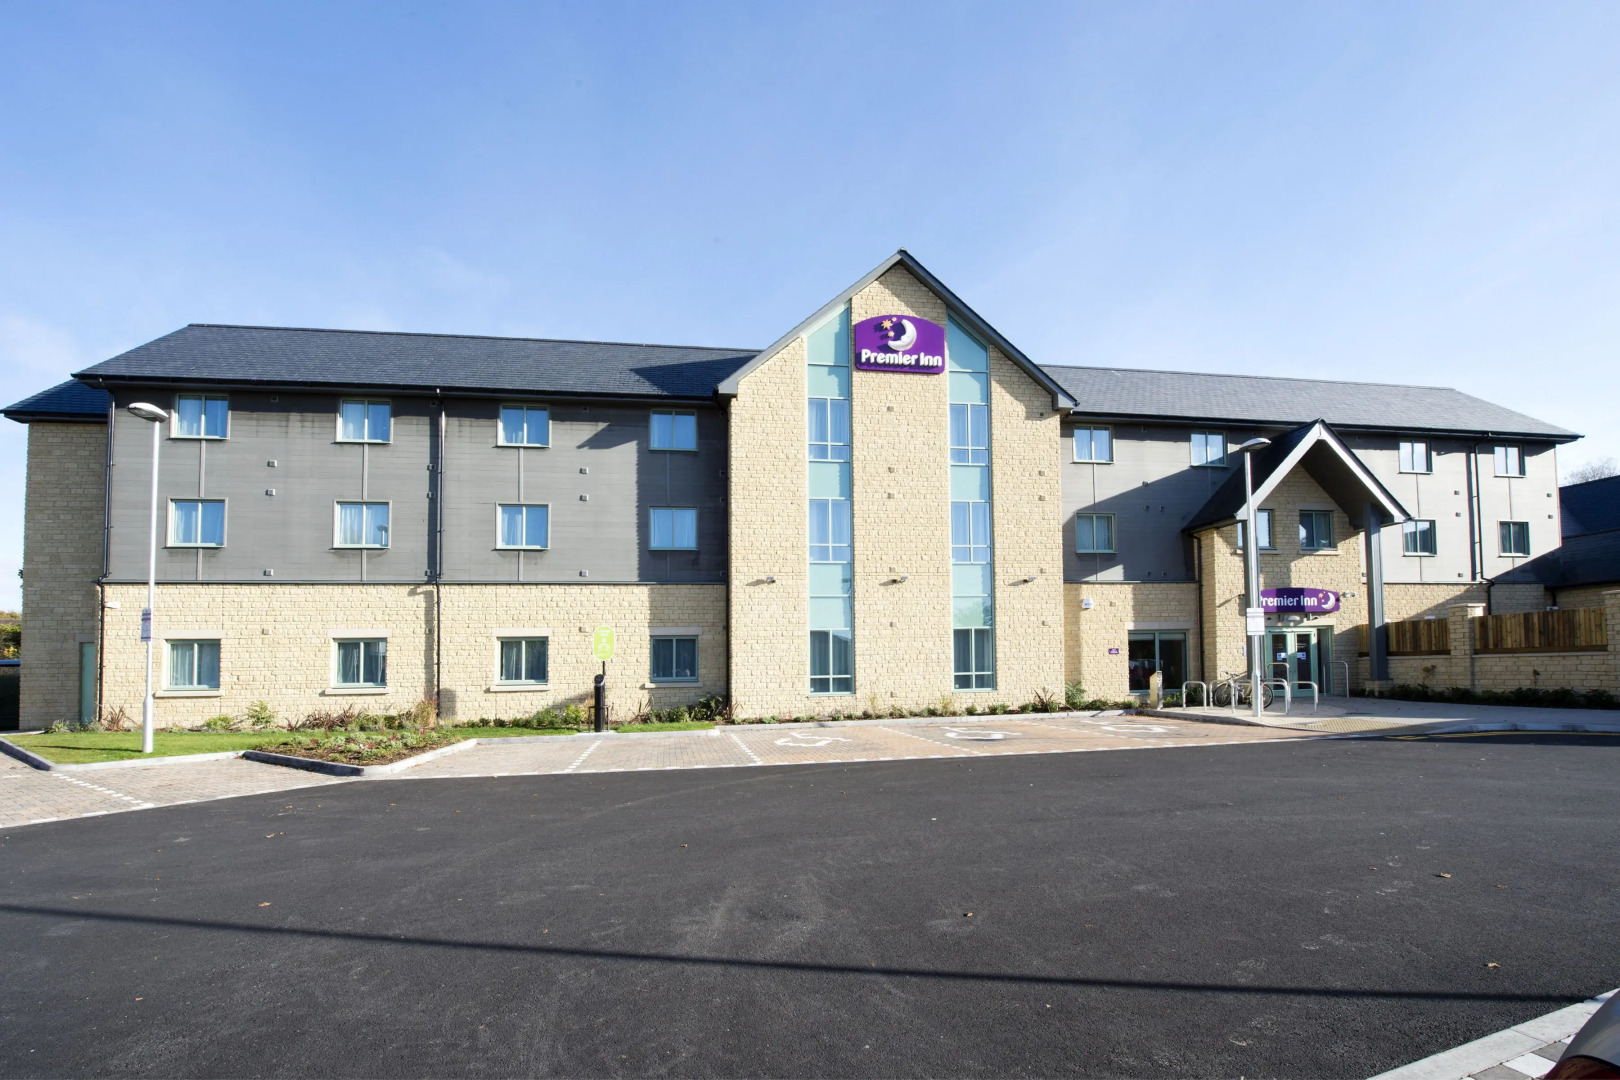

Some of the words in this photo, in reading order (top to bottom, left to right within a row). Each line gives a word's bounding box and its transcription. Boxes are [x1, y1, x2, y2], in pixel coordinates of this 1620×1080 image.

[861, 349, 918, 365] Premier
[919, 352, 942, 366] Inn
[1300, 595, 1317, 606] Inn
